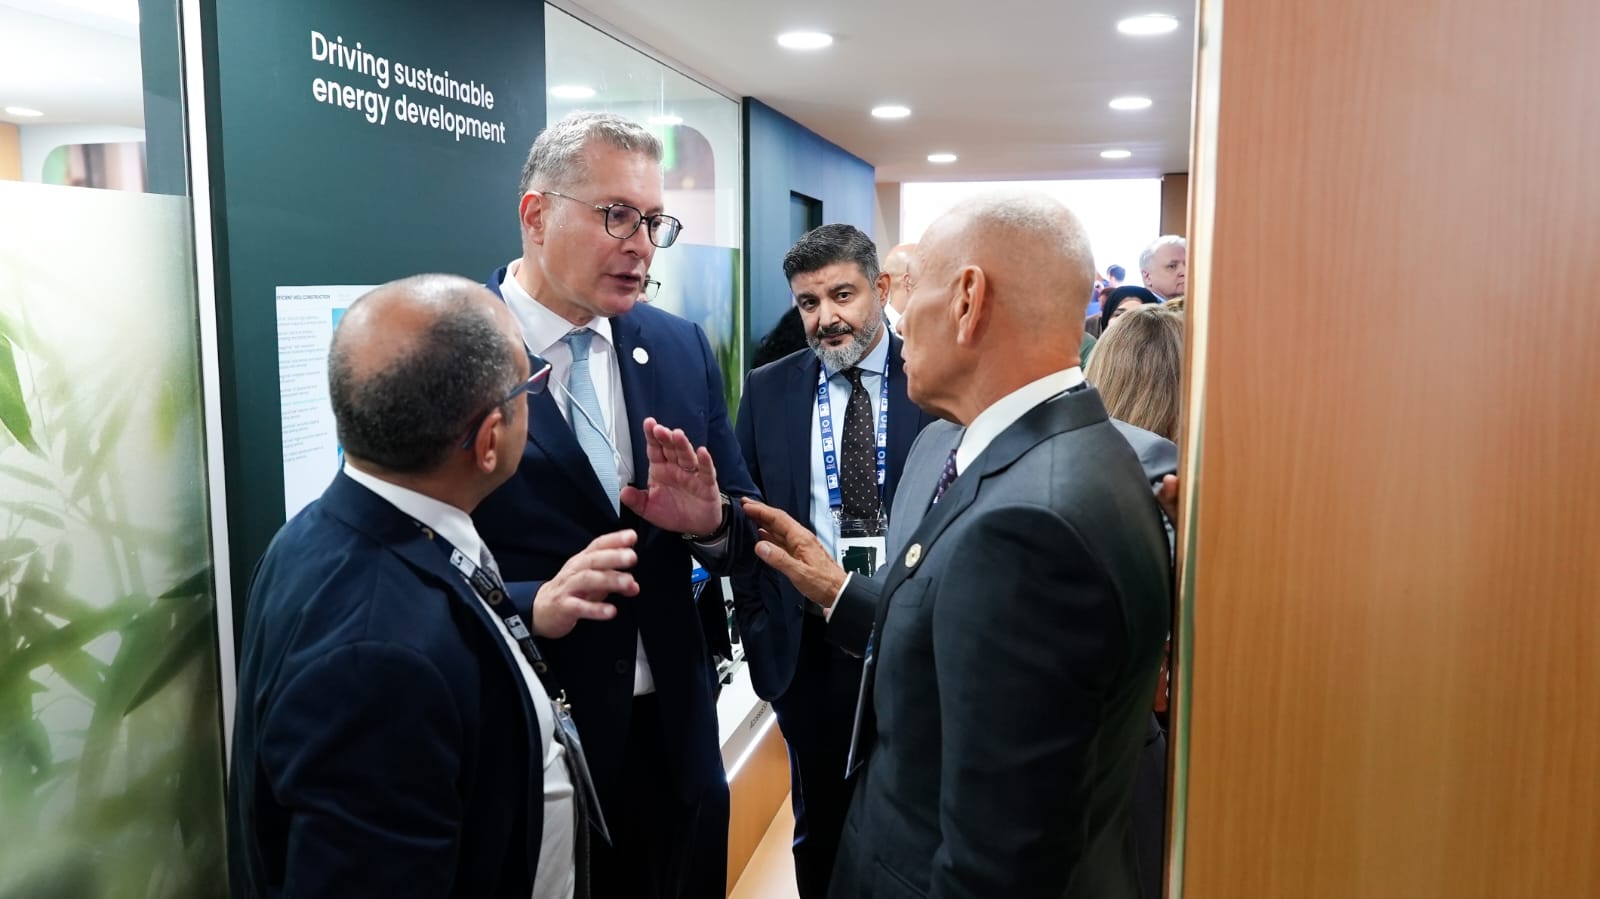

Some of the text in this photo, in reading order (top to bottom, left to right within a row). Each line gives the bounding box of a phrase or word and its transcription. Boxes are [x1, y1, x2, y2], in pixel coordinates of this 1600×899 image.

[311, 30, 494, 110] Driving sustainable
[312, 77, 506, 144] energy development
